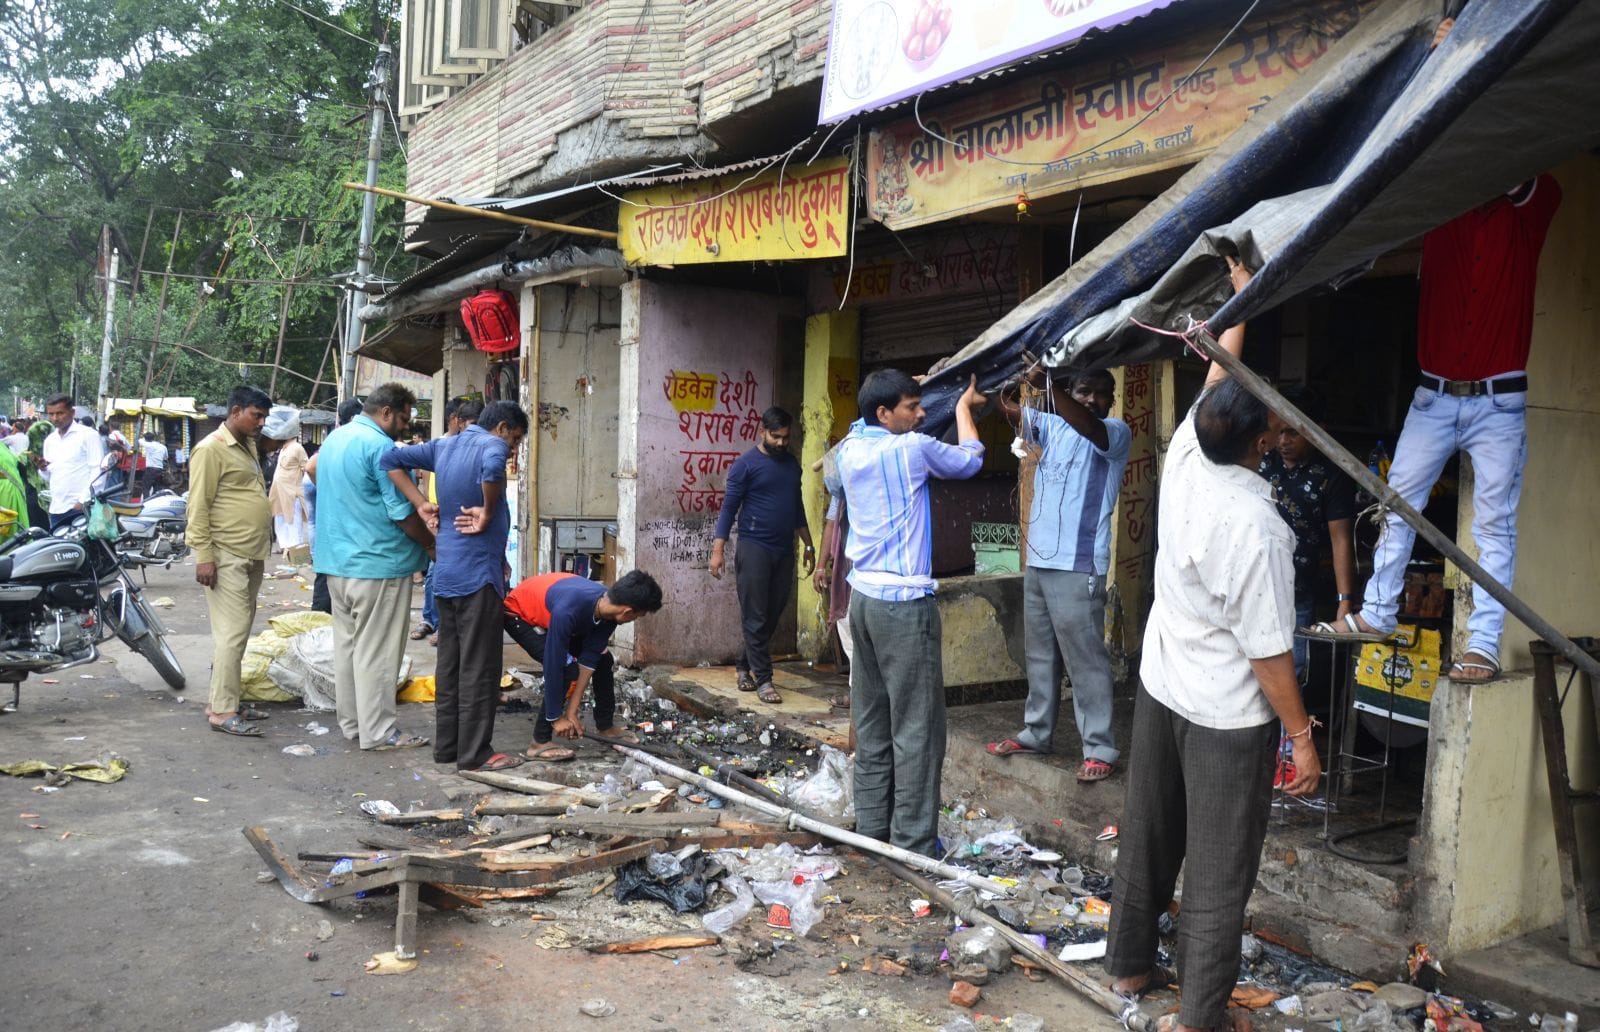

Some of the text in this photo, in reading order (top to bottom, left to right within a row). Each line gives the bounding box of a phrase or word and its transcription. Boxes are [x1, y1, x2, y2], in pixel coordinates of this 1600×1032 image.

[909, 120, 945, 178] श्री
[952, 81, 1067, 164] बालाजी
[1074, 56, 1167, 130] स्वीट
[635, 194, 689, 251] रोडवेज
[724, 182, 775, 243] शराब
[775, 171, 799, 223] की
[799, 168, 849, 249] दुकान
[663, 369, 758, 413] रोडवेज देशी
[1125, 378, 1148, 409] बुक
[679, 408, 762, 444] शराब की
[62, 551, 80, 560] Hero
